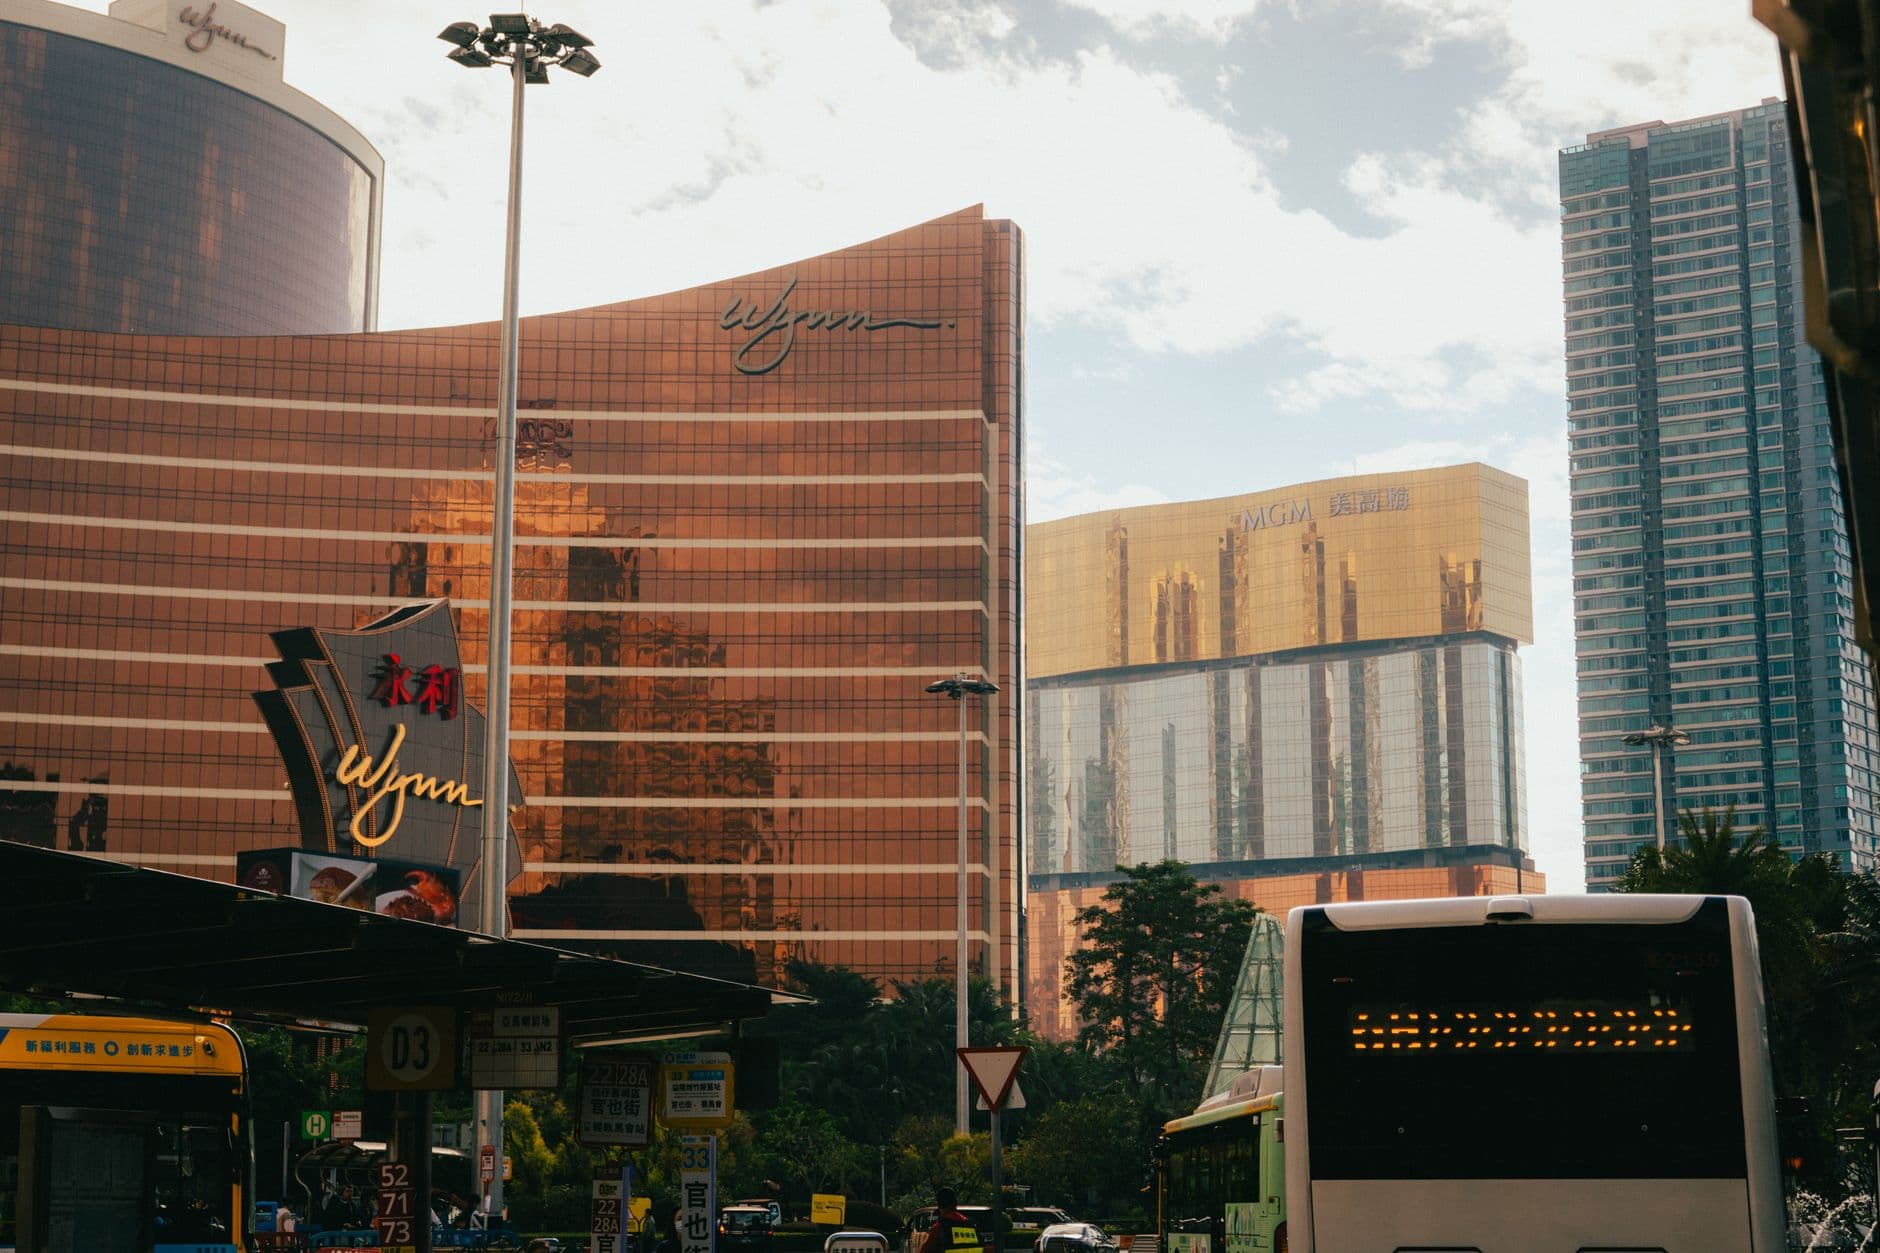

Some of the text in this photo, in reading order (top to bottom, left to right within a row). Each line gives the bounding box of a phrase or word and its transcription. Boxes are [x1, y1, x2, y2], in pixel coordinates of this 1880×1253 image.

[1242, 487, 1409, 533] MGM 美高梅
[368, 653, 460, 720] 永利
[336, 722, 484, 847] Wynn
[26, 1040, 194, 1058] 新福利服務 創新求進步
[391, 1025, 430, 1070] D3
[479, 1041, 489, 1053] 22
[520, 1041, 532, 1053] 33
[588, 1065, 649, 1086] 22 28A
[672, 1072, 683, 1081] 33
[591, 1098, 641, 1116] 官也街
[683, 1147, 710, 1169] 33
[381, 1164, 409, 1187] 52
[382, 1192, 408, 1215] 71
[597, 1200, 617, 1215] 22
[382, 1221, 411, 1243] 73
[593, 1217, 619, 1232] 28A
